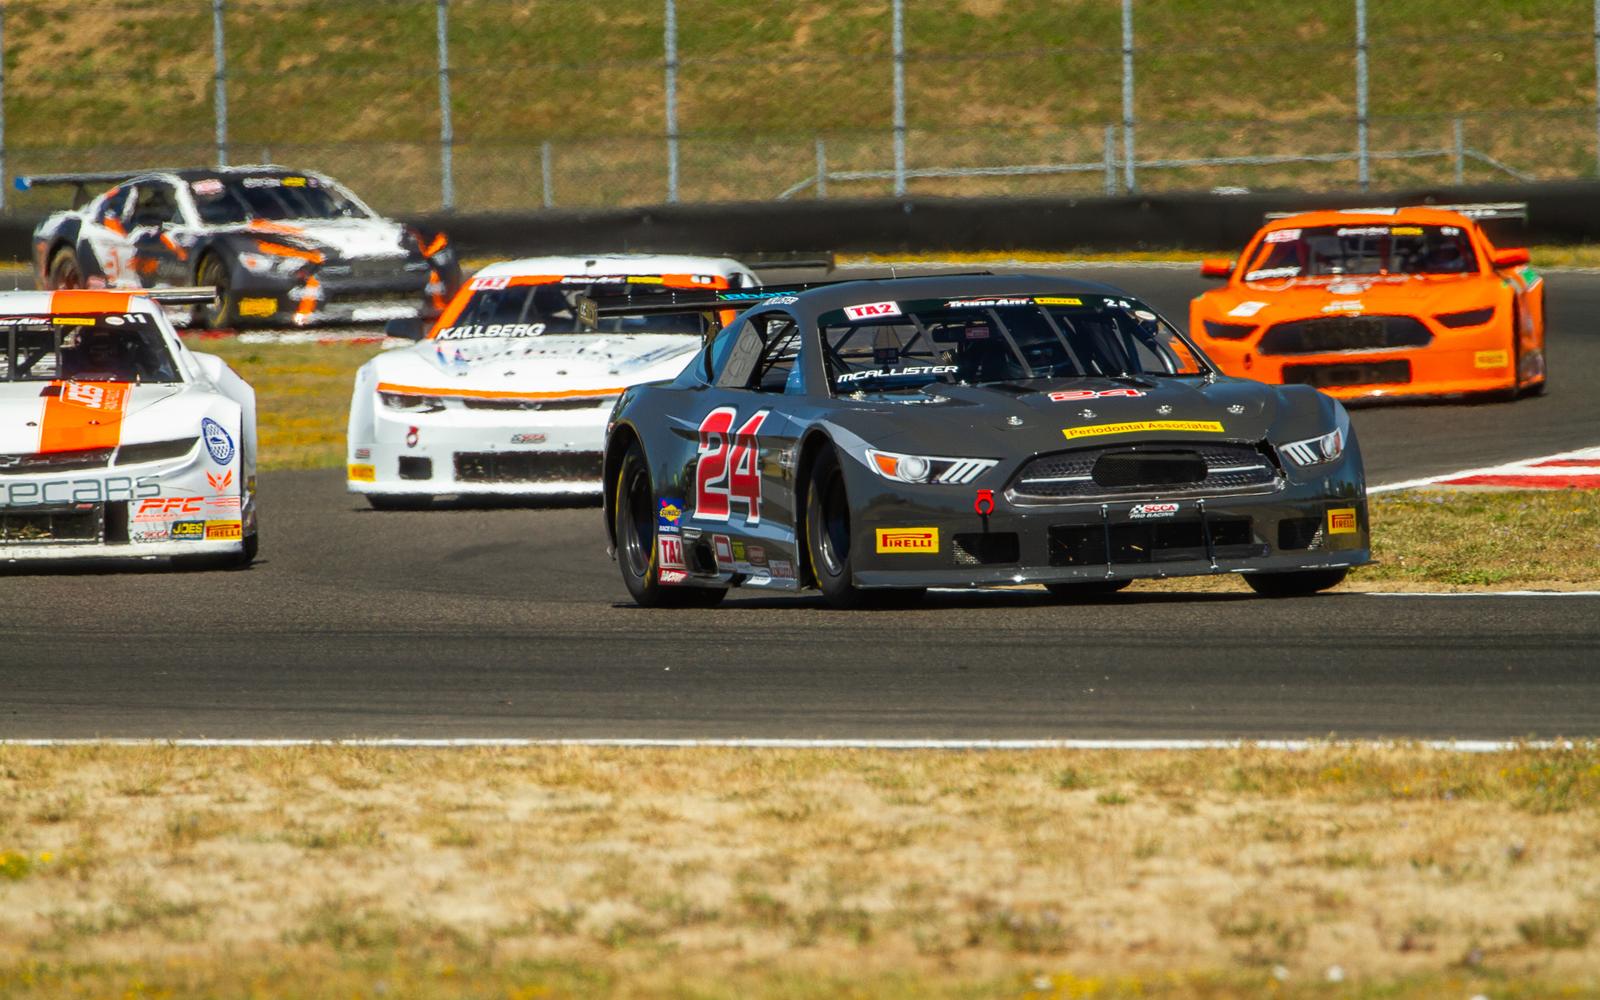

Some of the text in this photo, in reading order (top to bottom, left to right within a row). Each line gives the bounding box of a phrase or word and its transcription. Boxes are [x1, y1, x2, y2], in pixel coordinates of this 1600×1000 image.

[851, 303, 894, 317] TA2
[1103, 297, 1132, 309] 24
[123, 313, 147, 324] 11
[435, 323, 547, 340] KALLBERG
[836, 365, 959, 383] MCALLISTER
[1048, 388, 1147, 402] 24
[1068, 421, 1218, 437] Periodontal Associates
[692, 406, 771, 524] 24
[138, 496, 205, 514] PFC
[1144, 504, 1176, 513] SCCA
[172, 522, 203, 535] JOES
[206, 523, 241, 538] PIRELLI
[882, 533, 933, 548] PIRELLI
[661, 540, 684, 564] TA2
